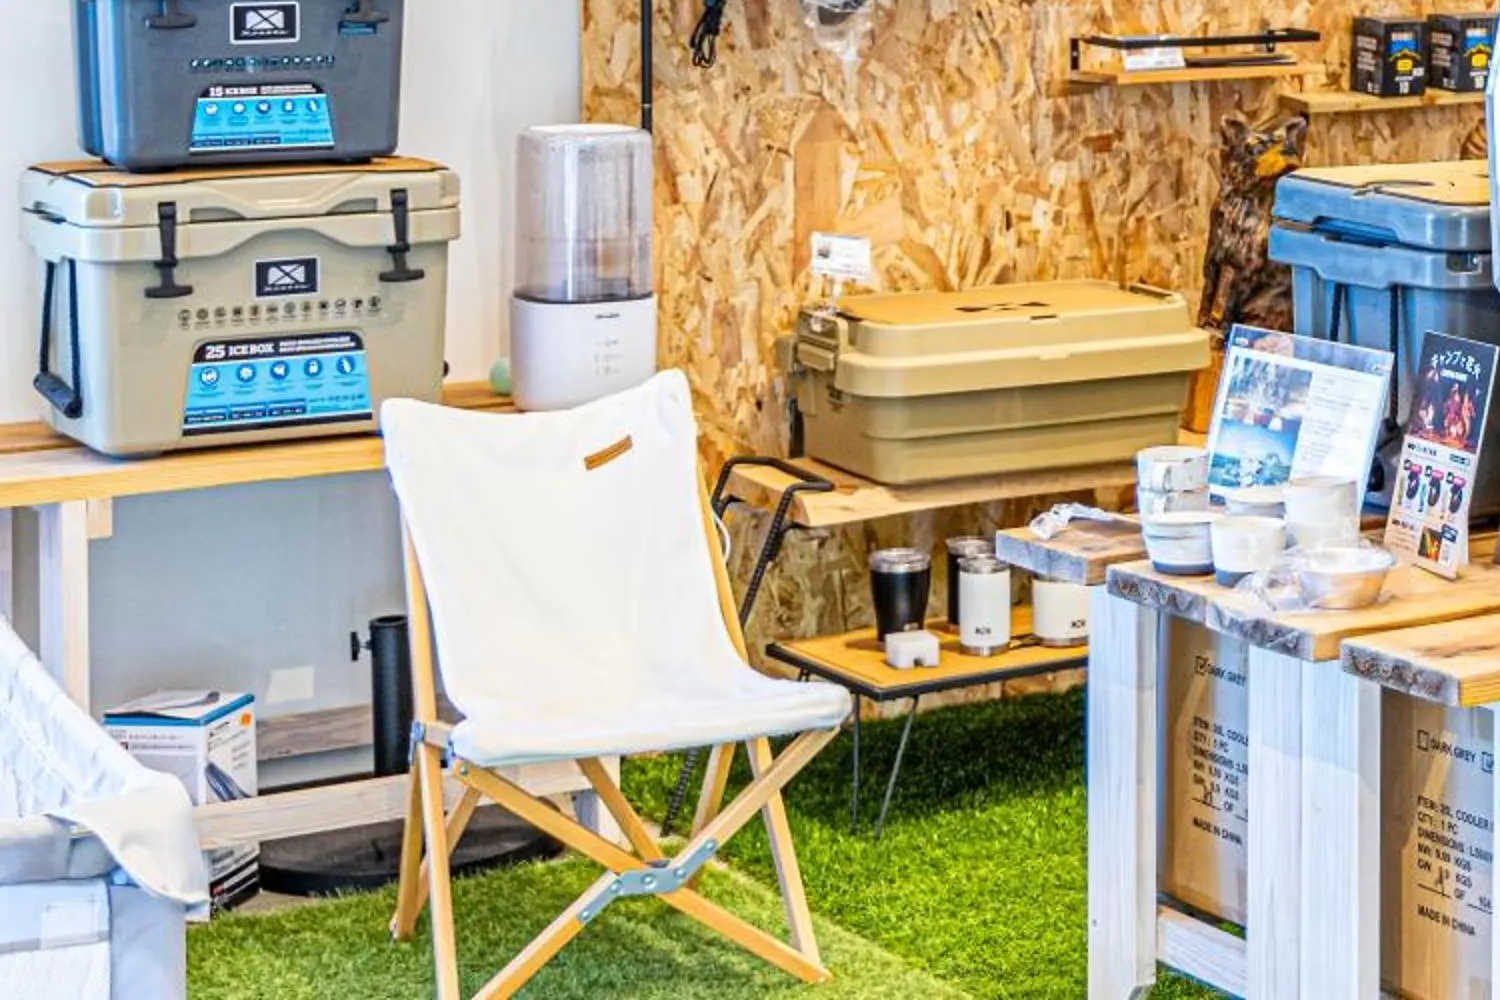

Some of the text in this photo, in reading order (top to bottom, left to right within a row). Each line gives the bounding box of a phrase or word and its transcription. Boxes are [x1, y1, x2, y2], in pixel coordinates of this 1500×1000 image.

[205, 345, 226, 360] 25
[1455, 809, 1489, 830] COOLER
[1417, 903, 1441, 924] MADE
[1451, 917, 1476, 937] CHINA
